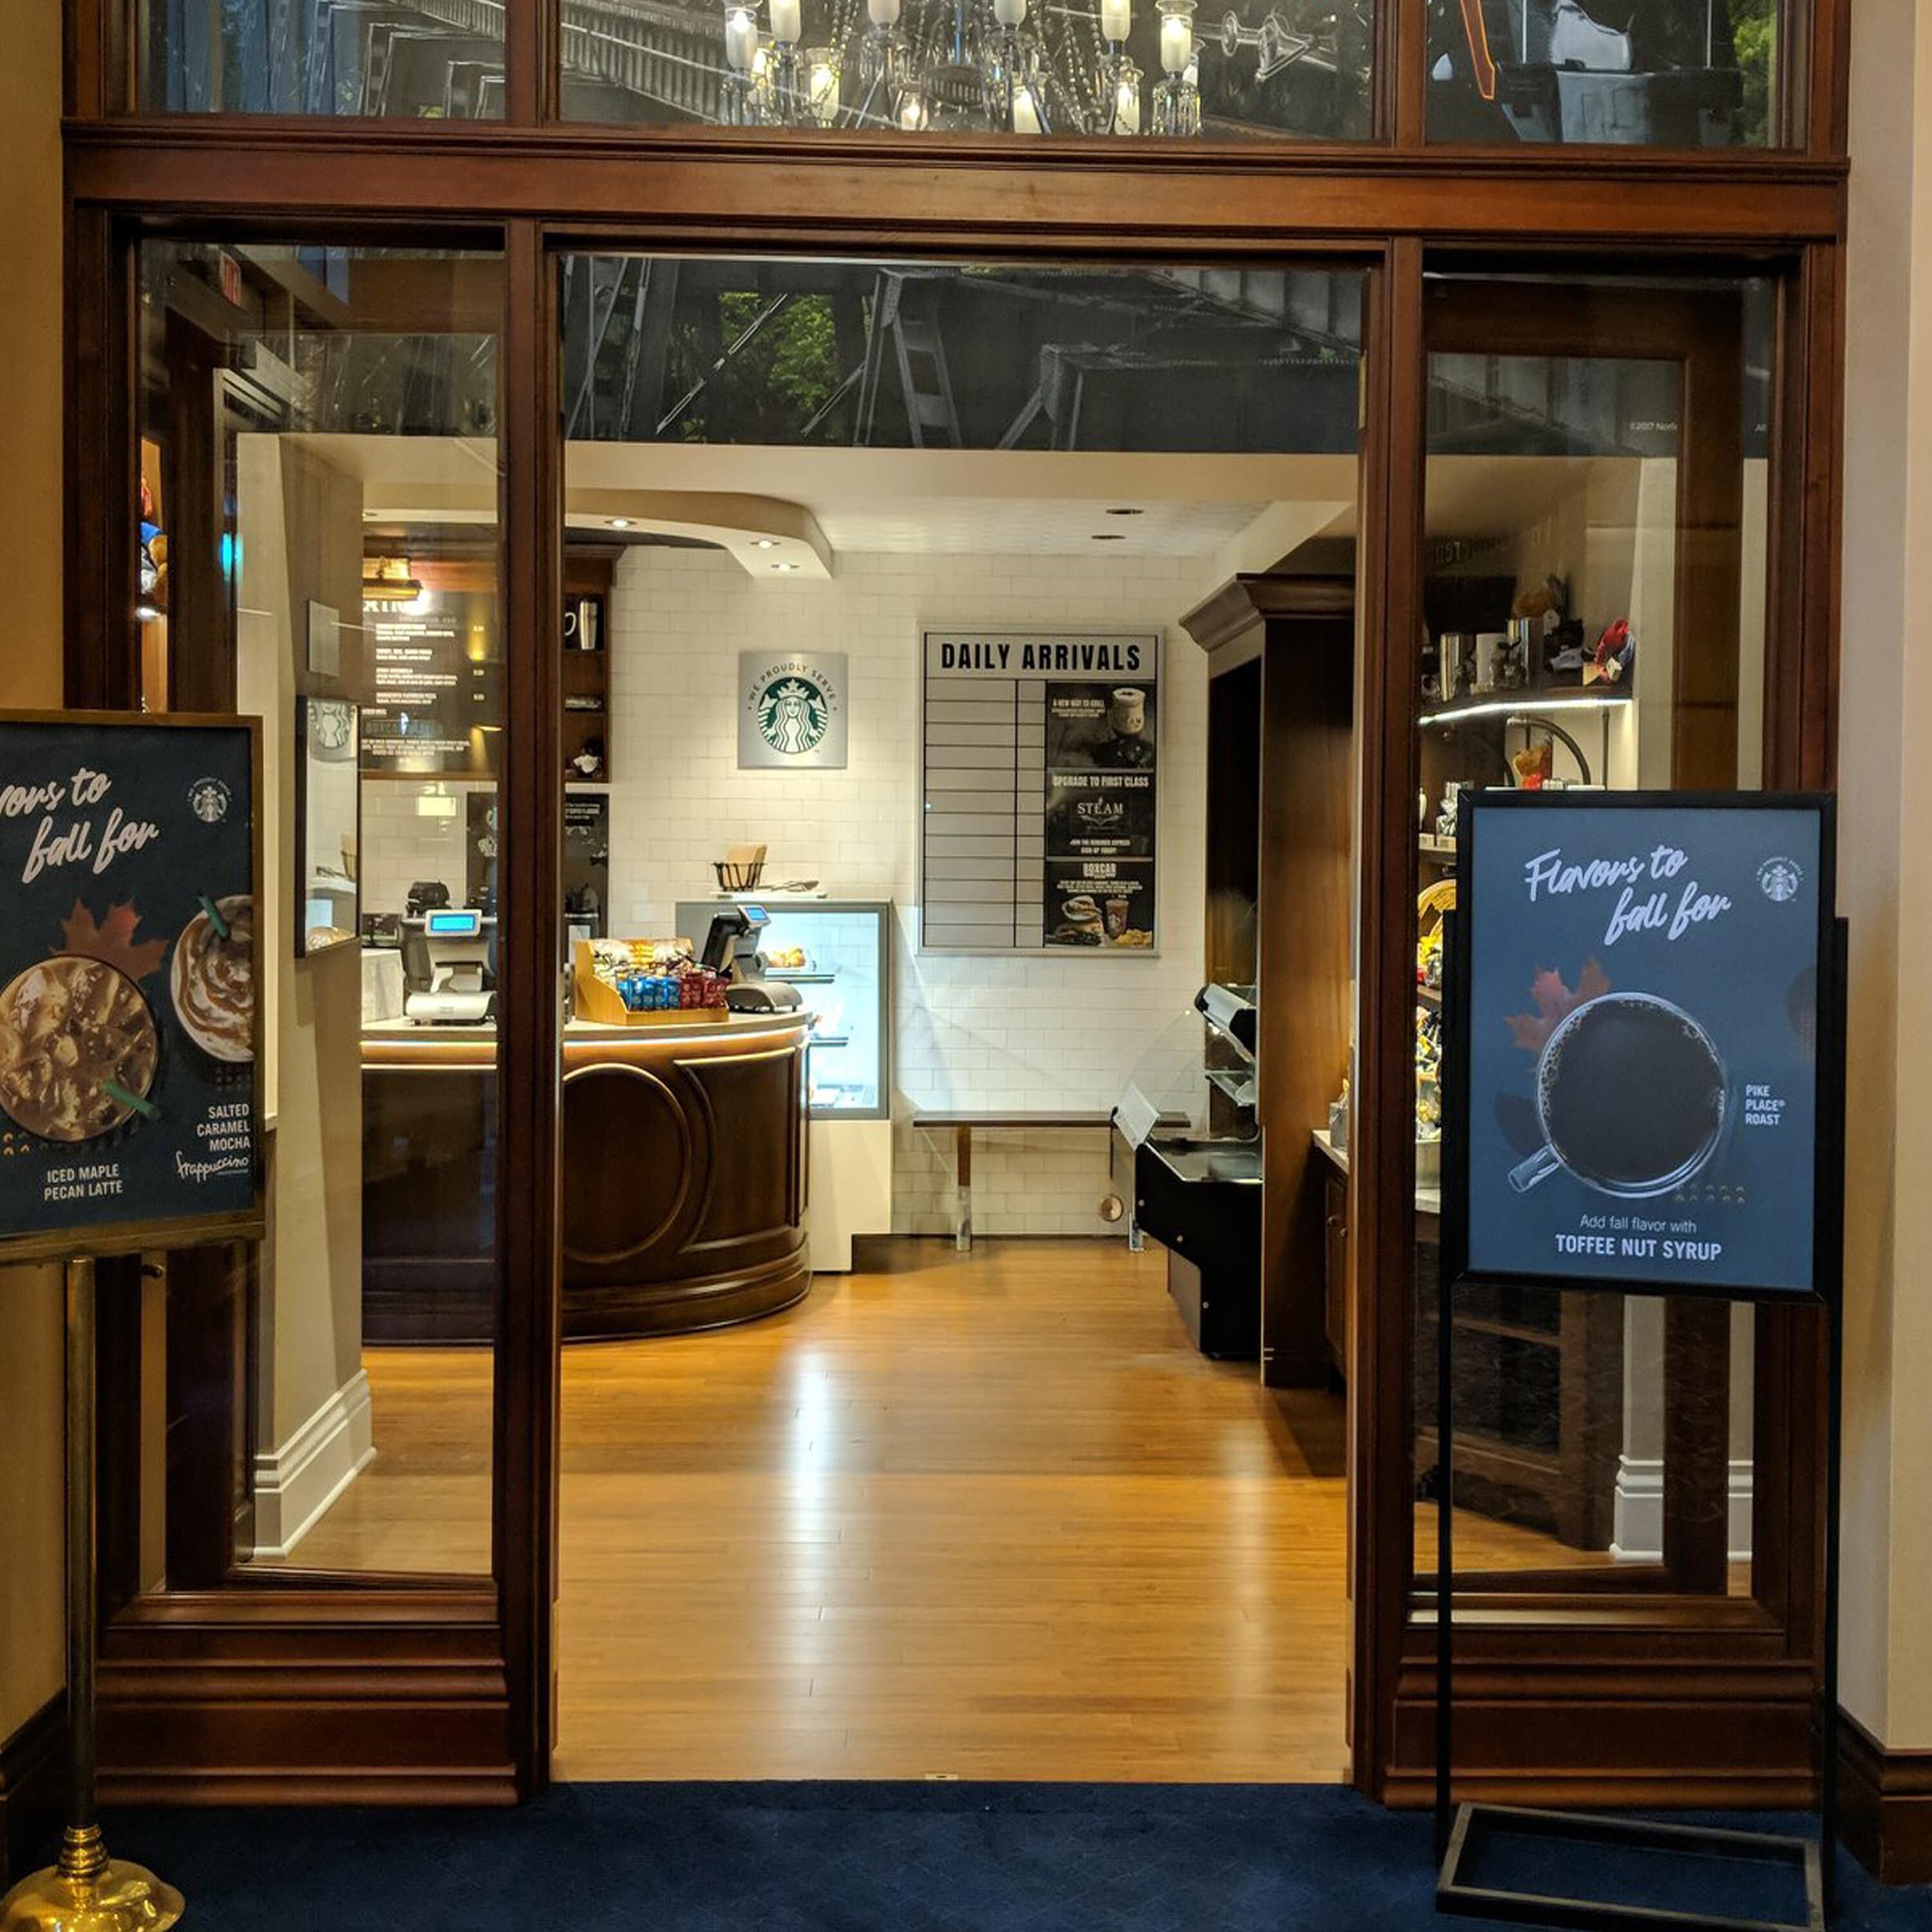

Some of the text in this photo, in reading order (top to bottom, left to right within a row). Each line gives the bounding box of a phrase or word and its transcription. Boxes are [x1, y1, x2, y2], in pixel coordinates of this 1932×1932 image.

[941, 643, 1141, 671] DAILY ARRIVALS
[748, 662, 837, 701] WE PROUDLY SERVE
[71, 767, 112, 806] to
[1090, 776, 1099, 787] TO
[1101, 776, 1123, 787] FIRST
[1124, 776, 1150, 788] CLASS
[22, 807, 160, 884] fall for
[1524, 844, 1688, 902] Flavors to
[1604, 880, 1732, 946] fall for
[1745, 1084, 1770, 1097] PIKE
[208, 1103, 249, 1119] SALTED
[1745, 1113, 1781, 1126] ROAST
[196, 1120, 251, 1137] CARAMEL
[209, 1136, 251, 1152] MOCHA
[48, 1164, 119, 1183] ICED MAPLE
[44, 1180, 123, 1200] PECAN LATTE
[1580, 1214, 1697, 1233] Add fall flavor with
[1555, 1234, 1722, 1261] TOFFEE NUT SYRUP
